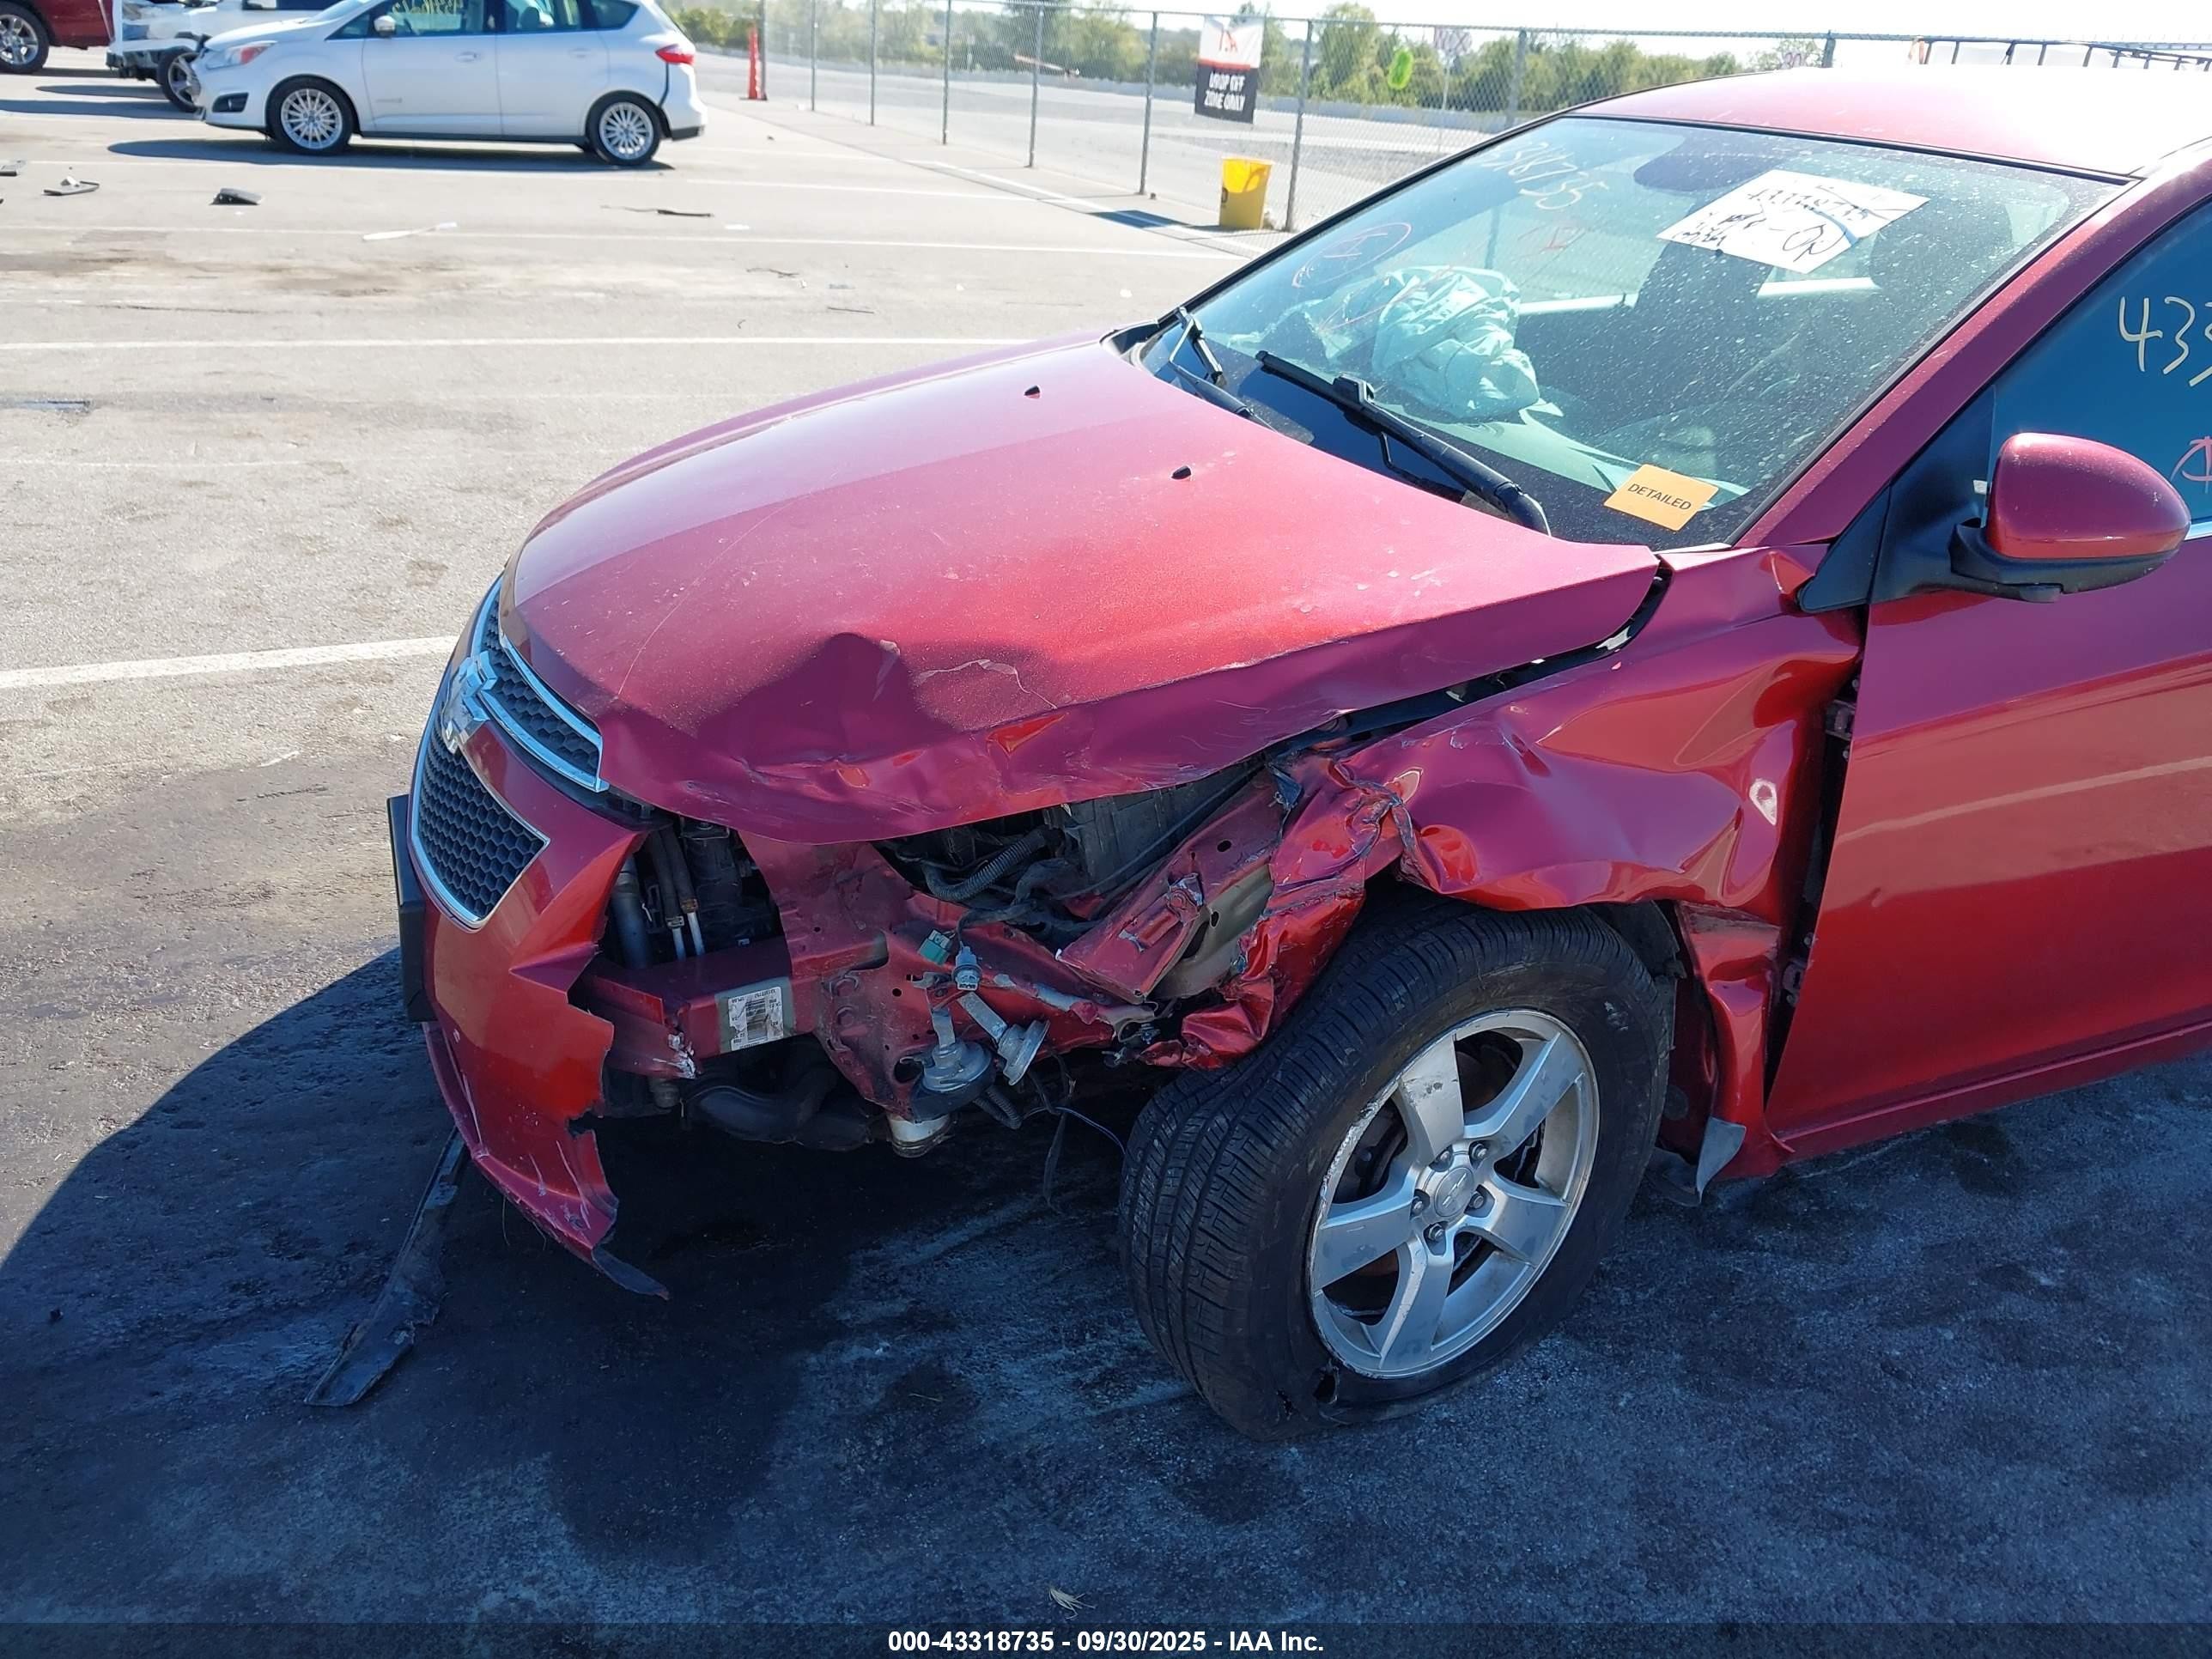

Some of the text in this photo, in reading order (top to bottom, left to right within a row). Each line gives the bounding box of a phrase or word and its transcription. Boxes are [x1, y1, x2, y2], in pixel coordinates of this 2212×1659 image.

[1205, 90, 1245, 111] ZONE ONLY
[1627, 483, 1692, 510] DETAILED
